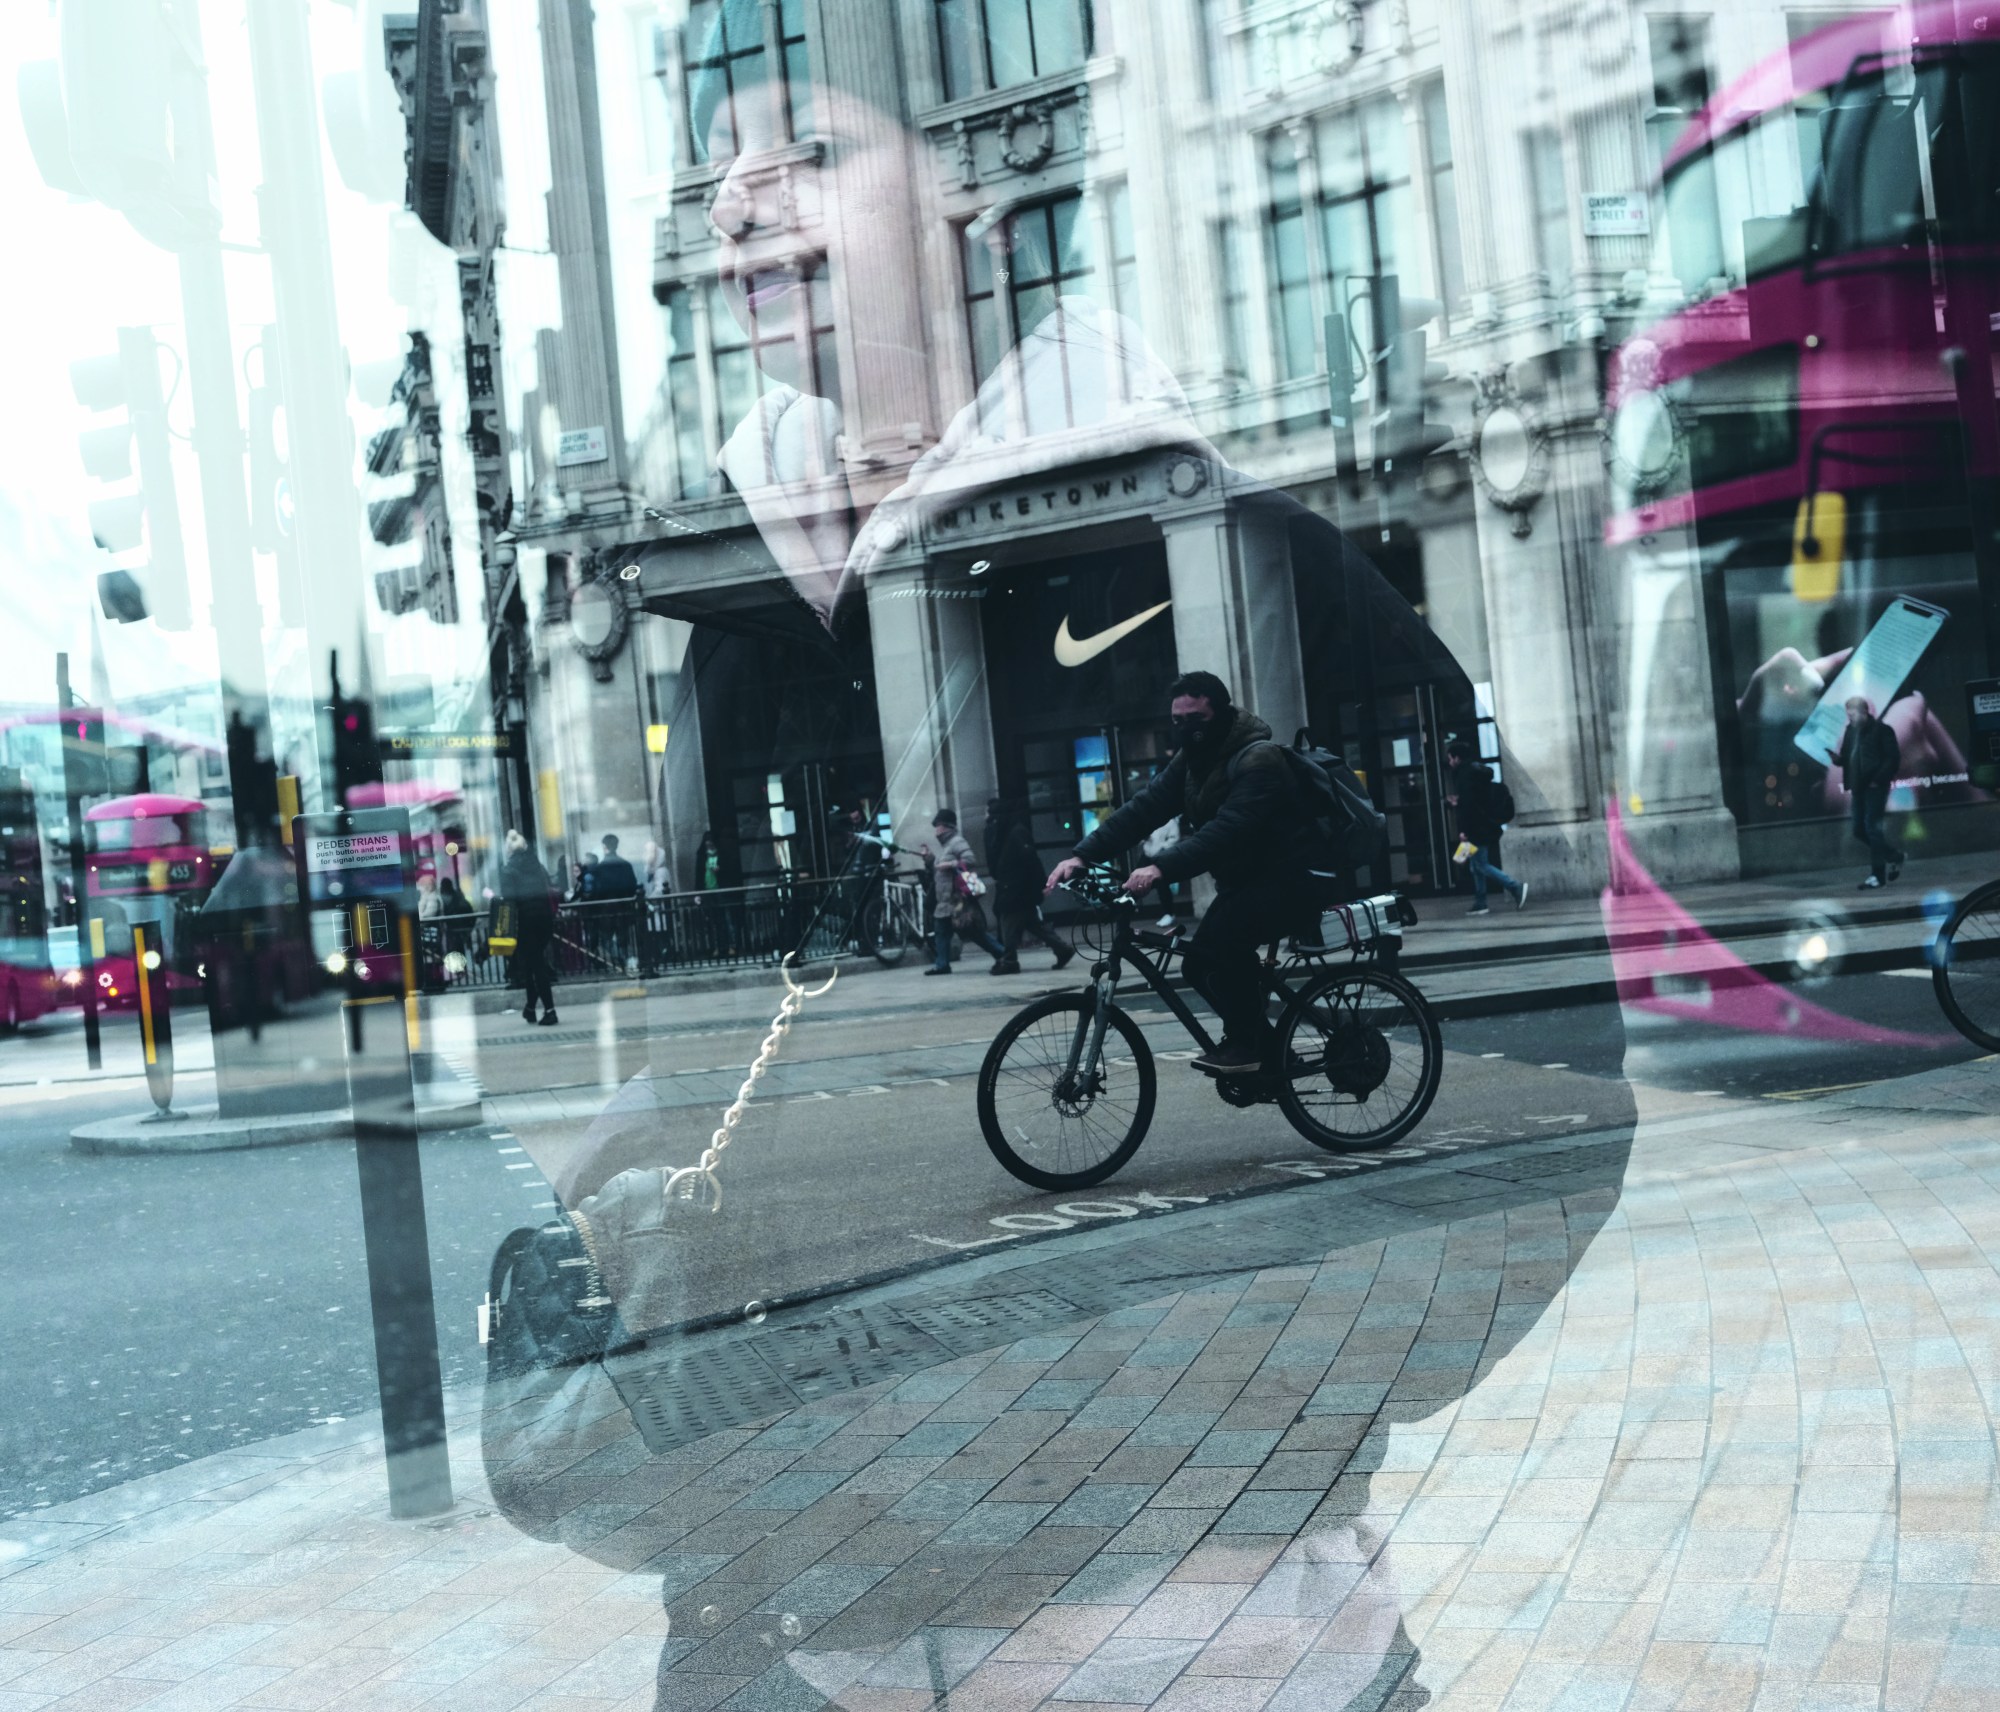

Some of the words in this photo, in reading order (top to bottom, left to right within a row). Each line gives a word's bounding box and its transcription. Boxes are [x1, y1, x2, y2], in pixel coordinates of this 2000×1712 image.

[1588, 197, 1627, 208] OXFORD
[1590, 209, 1625, 221] STREET
[941, 474, 1138, 529] NIKETOWN
[316, 835, 388, 850] PEDESTRIANS
[315, 851, 334, 859] push
[335, 846, 359, 856] button
[360, 845, 375, 854] and
[376, 844, 391, 852] wait
[320, 857, 331, 865] for
[332, 856, 355, 864] signal
[356, 853, 387, 862] opposite
[908, 1190, 1209, 1249] LOOK
